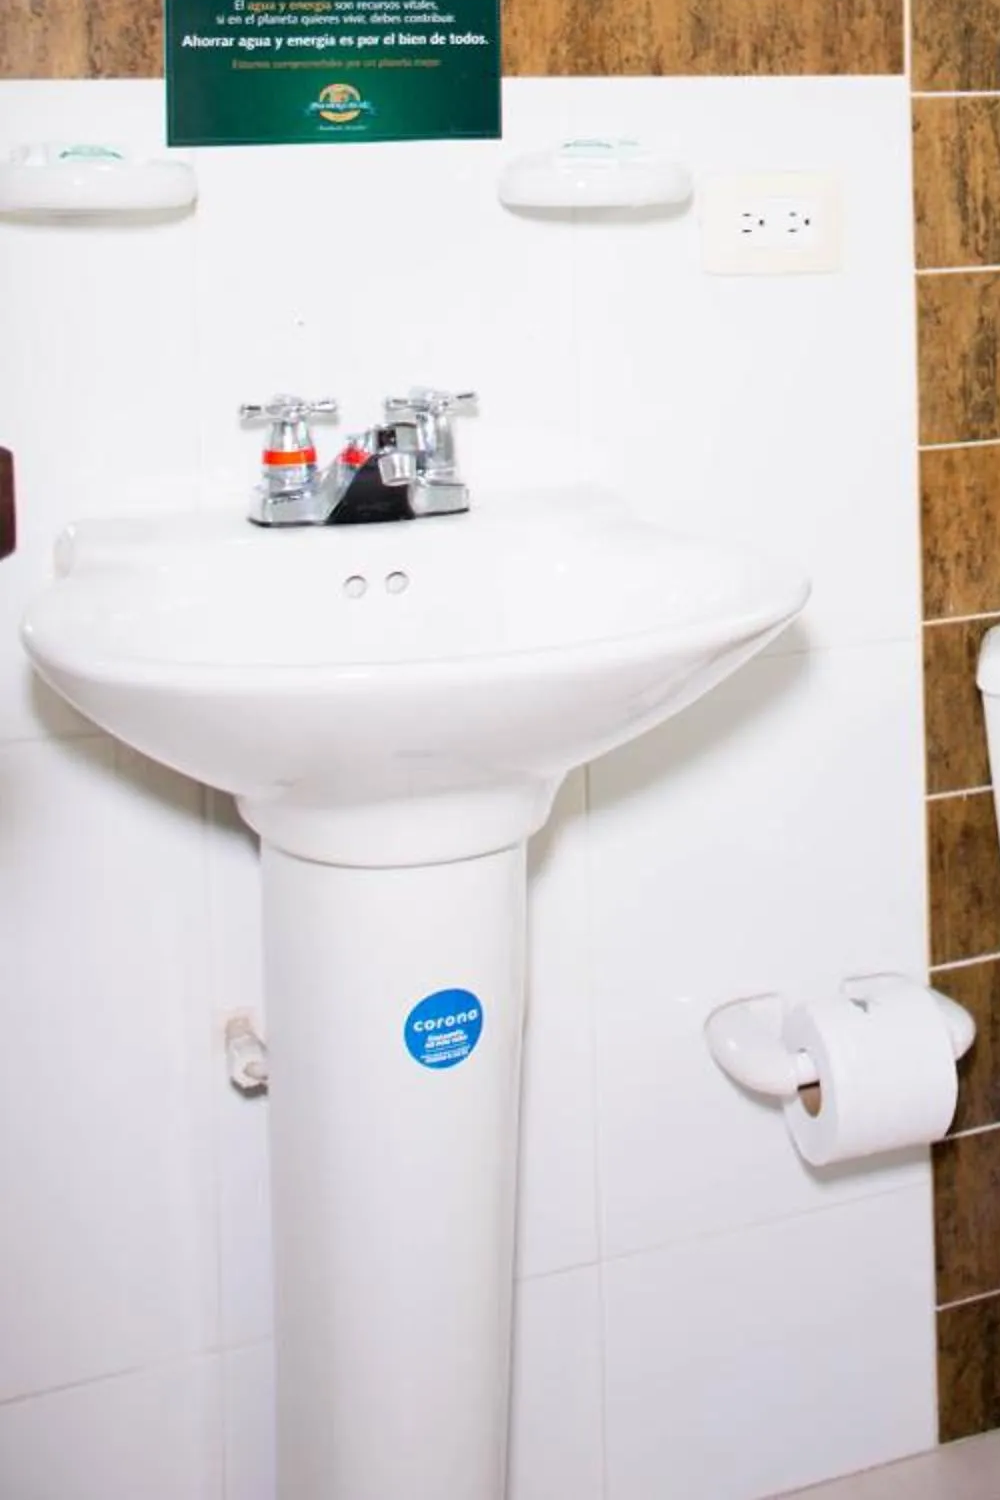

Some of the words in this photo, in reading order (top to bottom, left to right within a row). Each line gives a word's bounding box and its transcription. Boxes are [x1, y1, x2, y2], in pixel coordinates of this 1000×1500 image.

[234, 0, 245, 11] El
[247, 2, 276, 13] agua
[278, 2, 286, 12] y
[335, 1, 354, 10] son
[357, 1, 400, 10] recursos
[216, 14, 225, 24] si
[227, 15, 242, 24] en
[245, 14, 254, 24] el
[257, 13, 298, 26] planeta
[301, 14, 340, 26] quieres
[369, 13, 401, 23] debes
[182, 35, 235, 47] Ahorrar
[238, 37, 271, 50] agua
[275, 37, 284, 50] y
[339, 36, 354, 45] es
[357, 35, 380, 48] por
[383, 33, 395, 45] el
[398, 33, 427, 45] bien
[429, 32, 447, 45] de
[449, 32, 489, 45] todos.
[413, 1008, 479, 1032] corona
